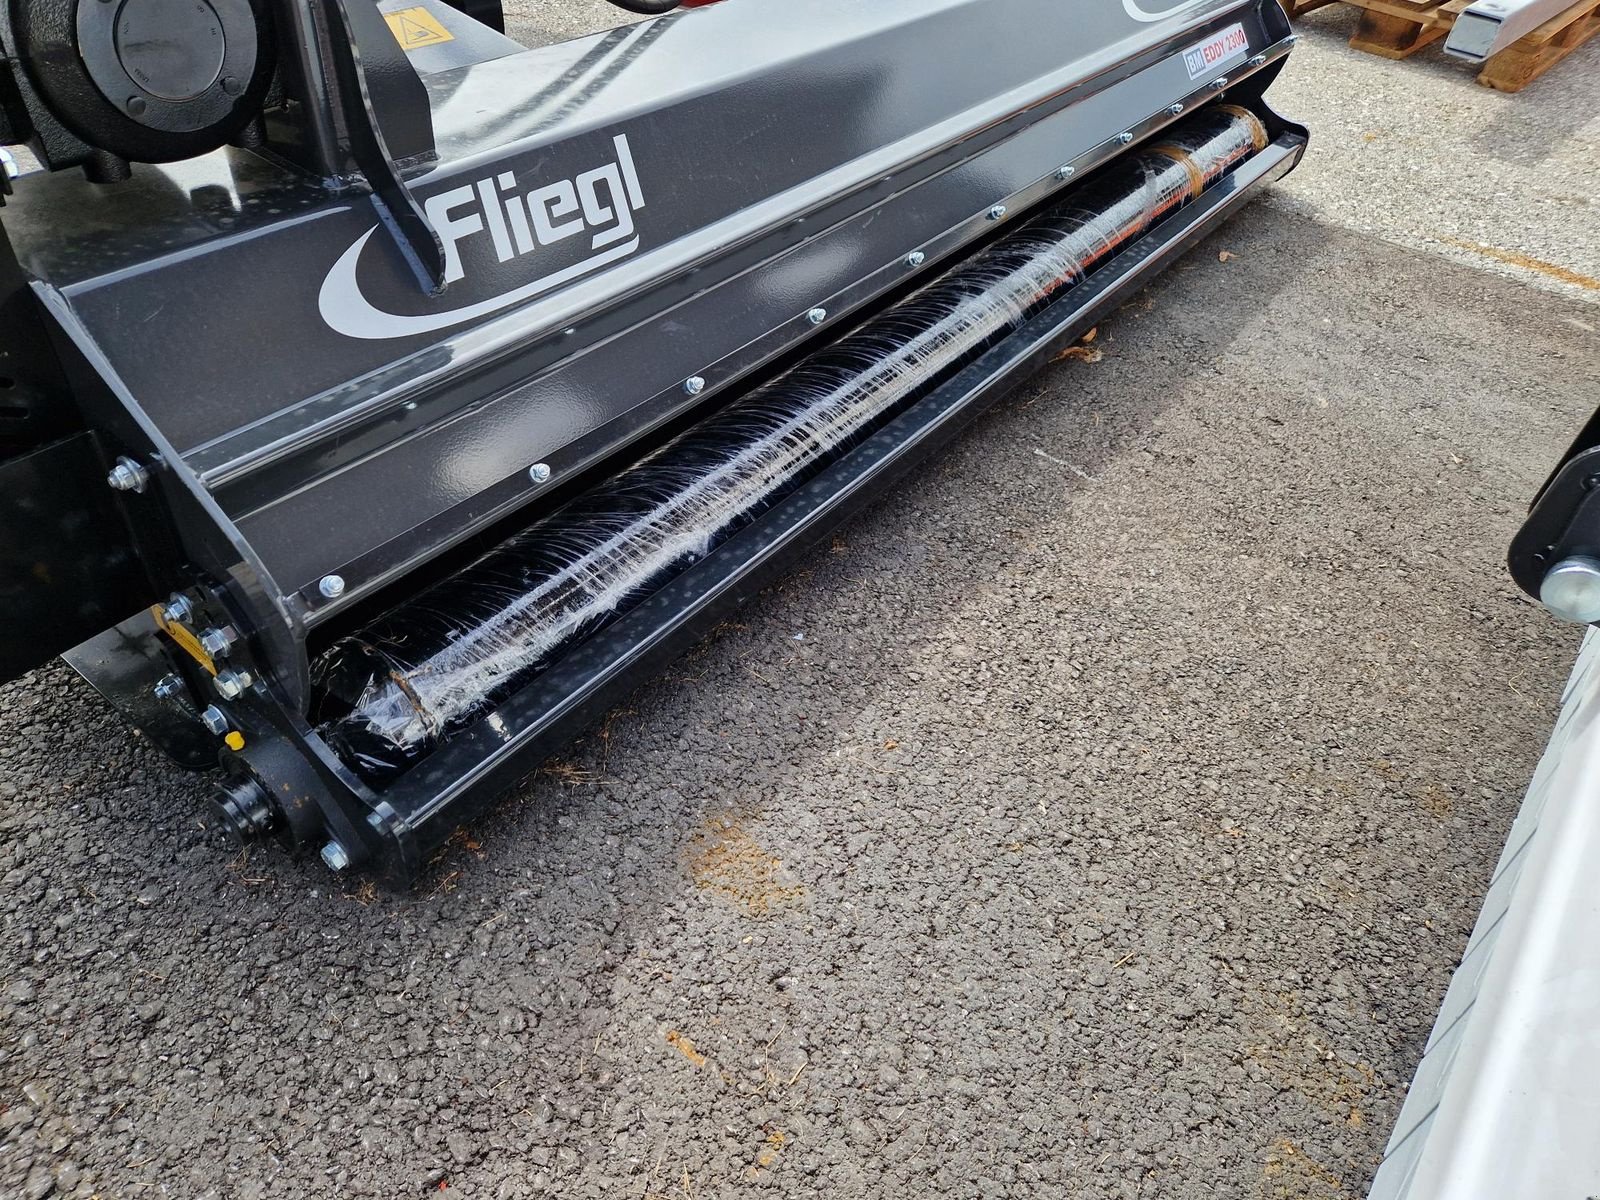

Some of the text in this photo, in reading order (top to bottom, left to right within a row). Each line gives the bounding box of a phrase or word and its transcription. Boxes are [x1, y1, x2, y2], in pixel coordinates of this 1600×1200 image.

[1187, 29, 1245, 73] BM EDDY 2300
[424, 133, 645, 284] Fliegl
